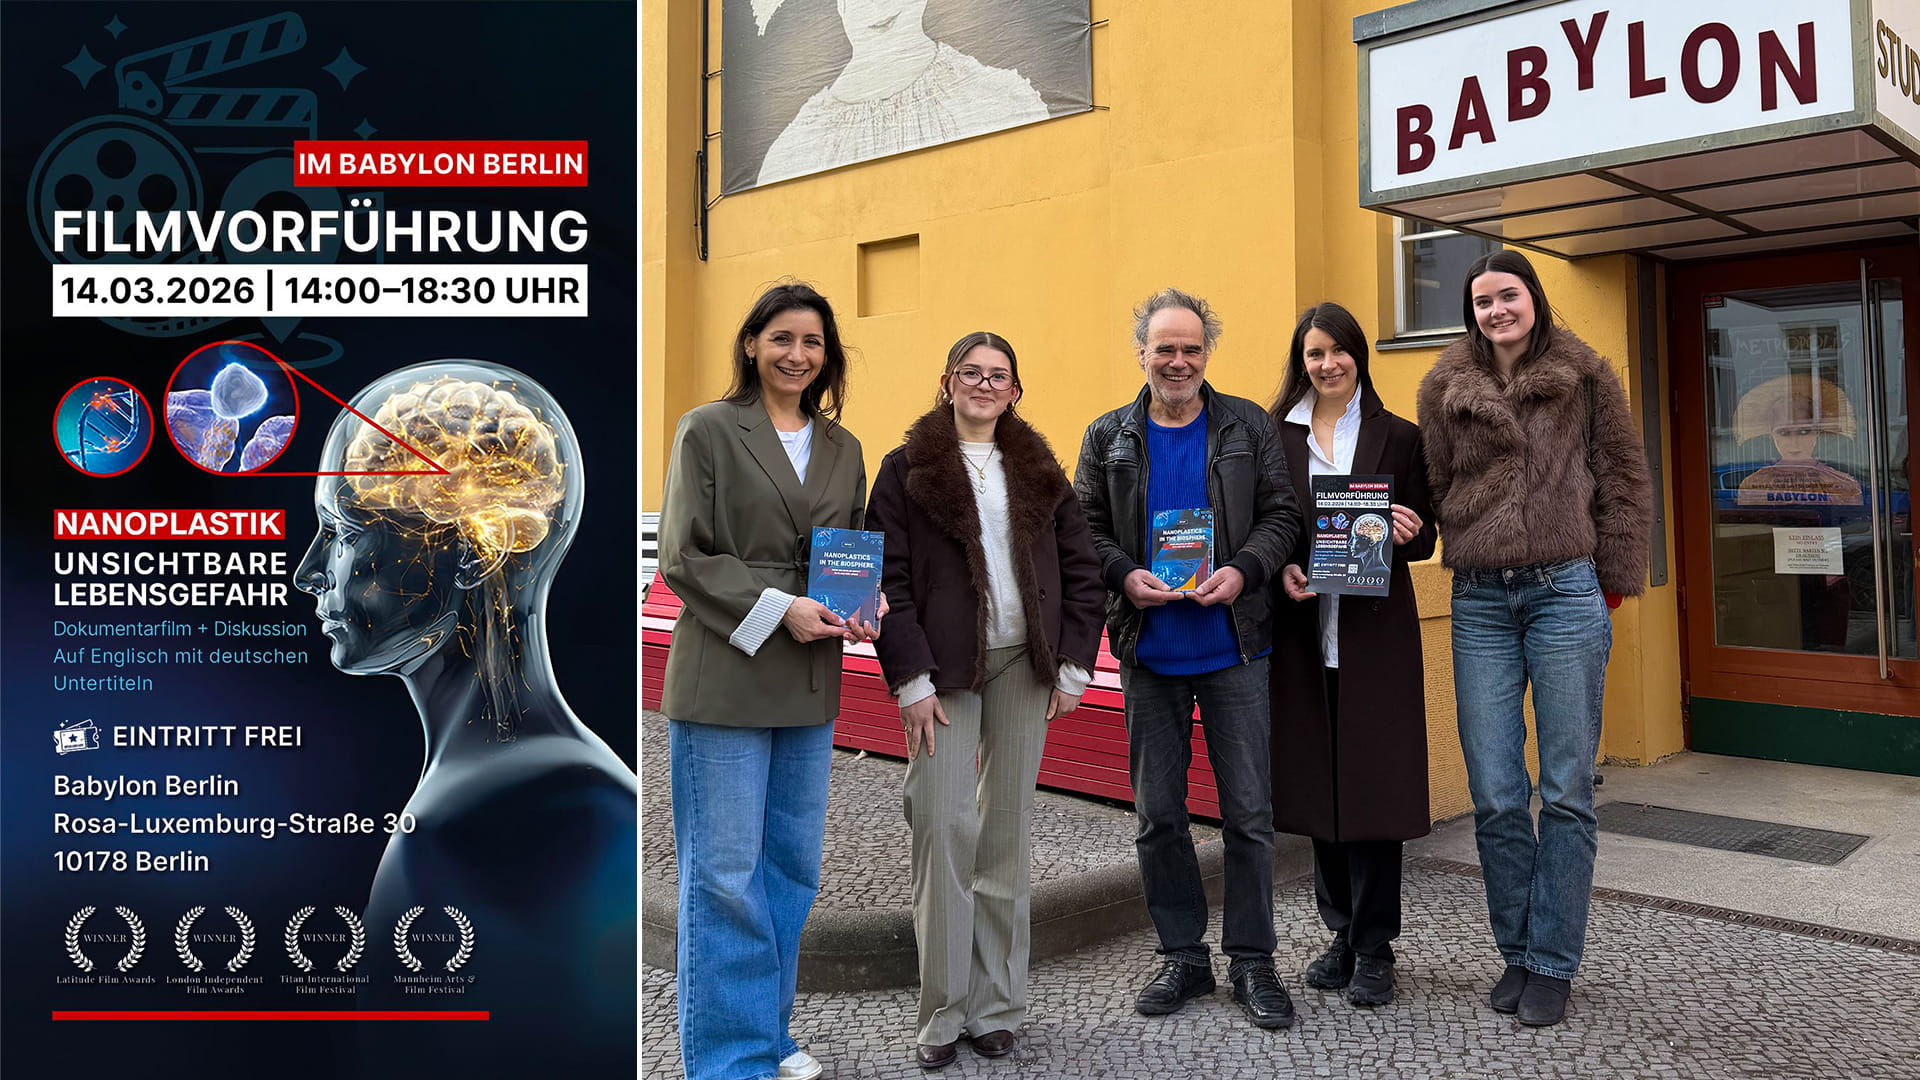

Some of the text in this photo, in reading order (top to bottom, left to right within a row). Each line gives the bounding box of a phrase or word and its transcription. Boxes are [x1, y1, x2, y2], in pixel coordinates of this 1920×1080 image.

[1396, 10, 1818, 175] BABYLON
[299, 152, 583, 175] IM BABYLON BERLIN
[54, 198, 588, 253] FILMVORFÜHRUNG
[61, 276, 255, 304] 14.03.2026
[506, 277, 580, 304] UHR
[1316, 491, 1389, 500] FILMVORFÜHRUNG
[1766, 492, 1829, 502] BABYLON
[56, 511, 282, 536] NANOPLASTIK
[823, 552, 871, 560] NANOPLASTICS
[54, 551, 287, 575] UNSICHTBARE
[840, 560, 875, 569] BIOSPHERE
[54, 582, 289, 606] LEBENSGEFAHR
[54, 619, 192, 637] Dokumentarfilm
[214, 620, 307, 637] Diskussion
[53, 648, 308, 668] Auf Englisch mit deutschen
[53, 675, 153, 691] Untertiteln
[113, 725, 301, 747] EINTRITT FREI
[54, 774, 239, 801] Babylon Berlin
[54, 812, 416, 839] Rosa-Luxemburg-Straße 30
[54, 850, 209, 872] 10178 Berlin
[83, 934, 127, 943] WINNER
[193, 934, 237, 943] WINNER
[302, 934, 347, 943] WINNER
[411, 934, 455, 943] WINNER
[56, 975, 156, 984] Latitude Film Awards
[166, 975, 264, 986] London Independent
[280, 975, 370, 984] Titan International
[393, 975, 442, 984] Mannheim
[445, 975, 465, 984] Arts
[186, 986, 245, 994] Film Awards
[295, 986, 356, 994] Film Festival
[404, 986, 465, 994] Film Festival
